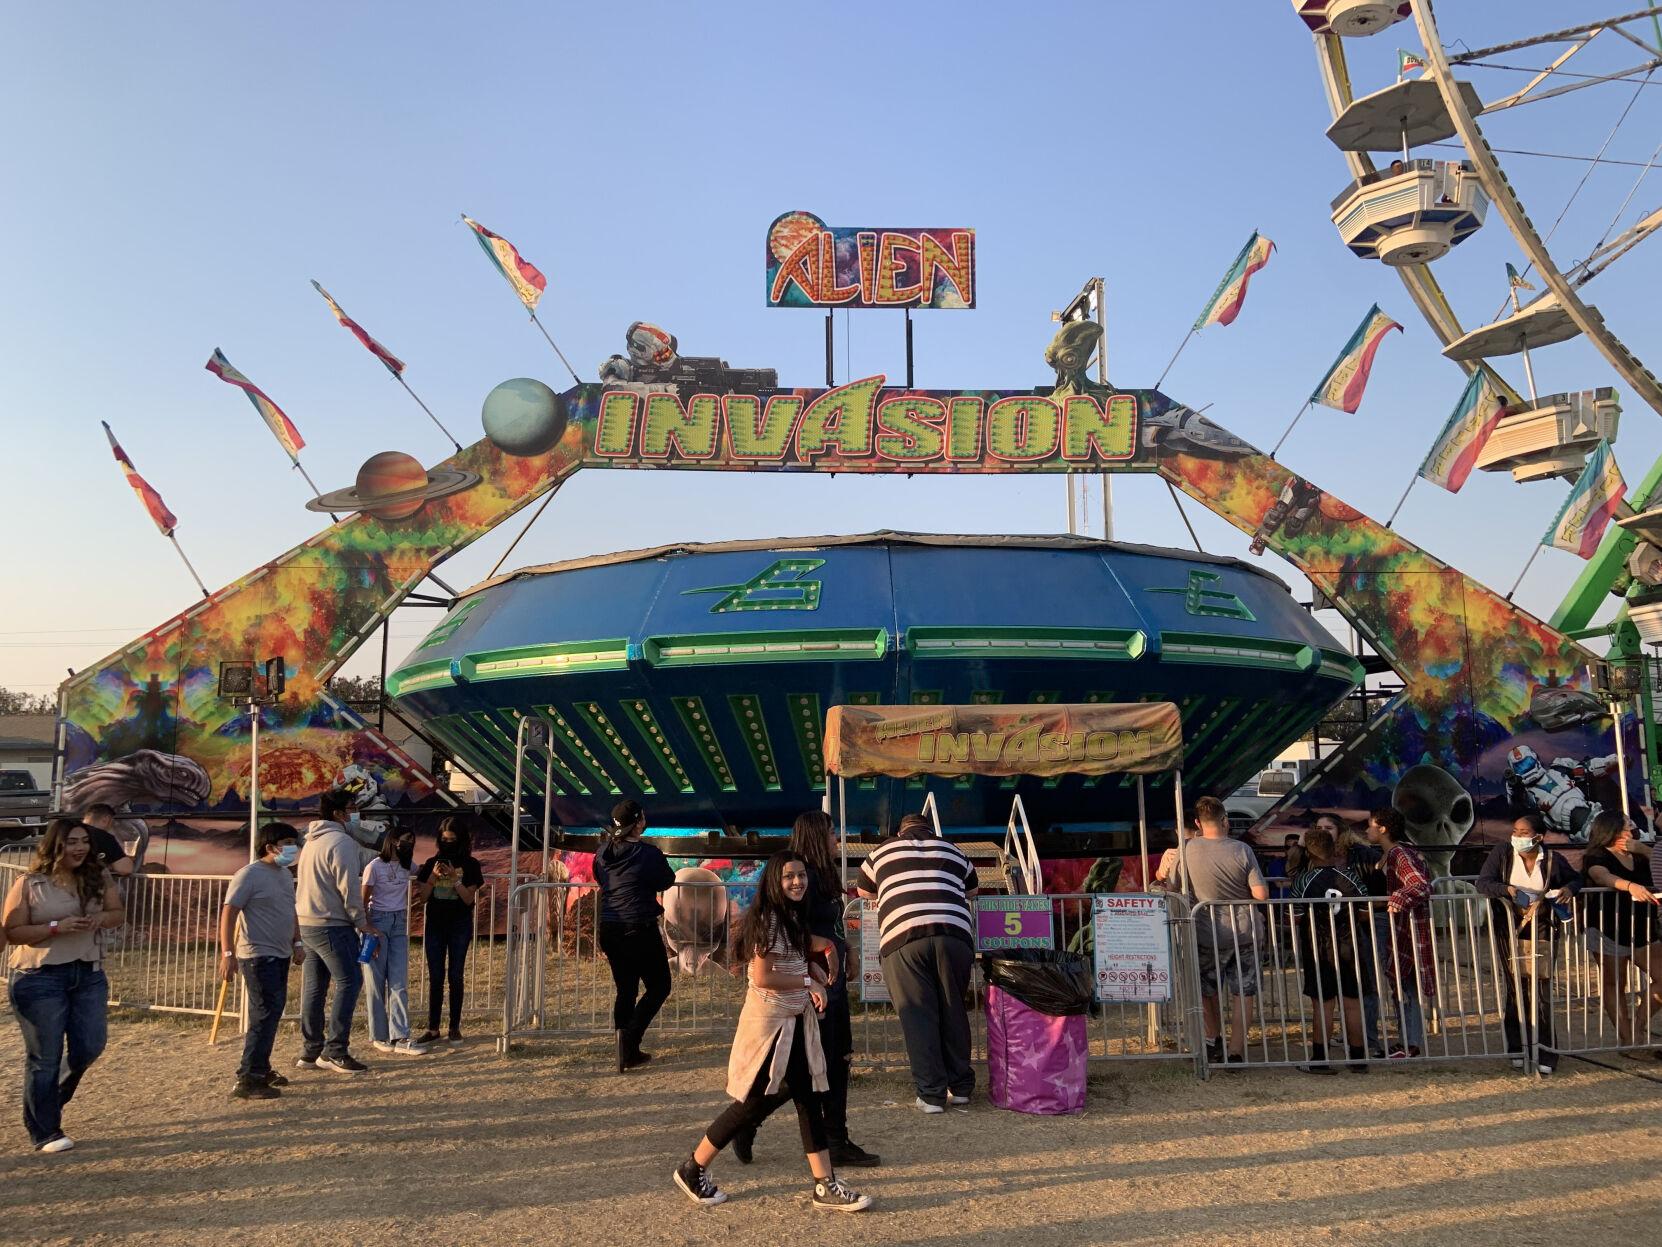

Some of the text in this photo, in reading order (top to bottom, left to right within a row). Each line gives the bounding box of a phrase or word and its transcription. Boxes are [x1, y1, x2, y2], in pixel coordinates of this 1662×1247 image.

[770, 231, 973, 304] ALIEN
[593, 374, 1139, 464] INVASION
[875, 713, 953, 744] ALIEN
[917, 723, 1152, 767] INVASION
[979, 899, 1050, 911] THIS RIDE TAKES
[1107, 898, 1154, 908] SAFETY
[1004, 912, 1022, 935] 5
[981, 937, 1051, 949] COUPONS
